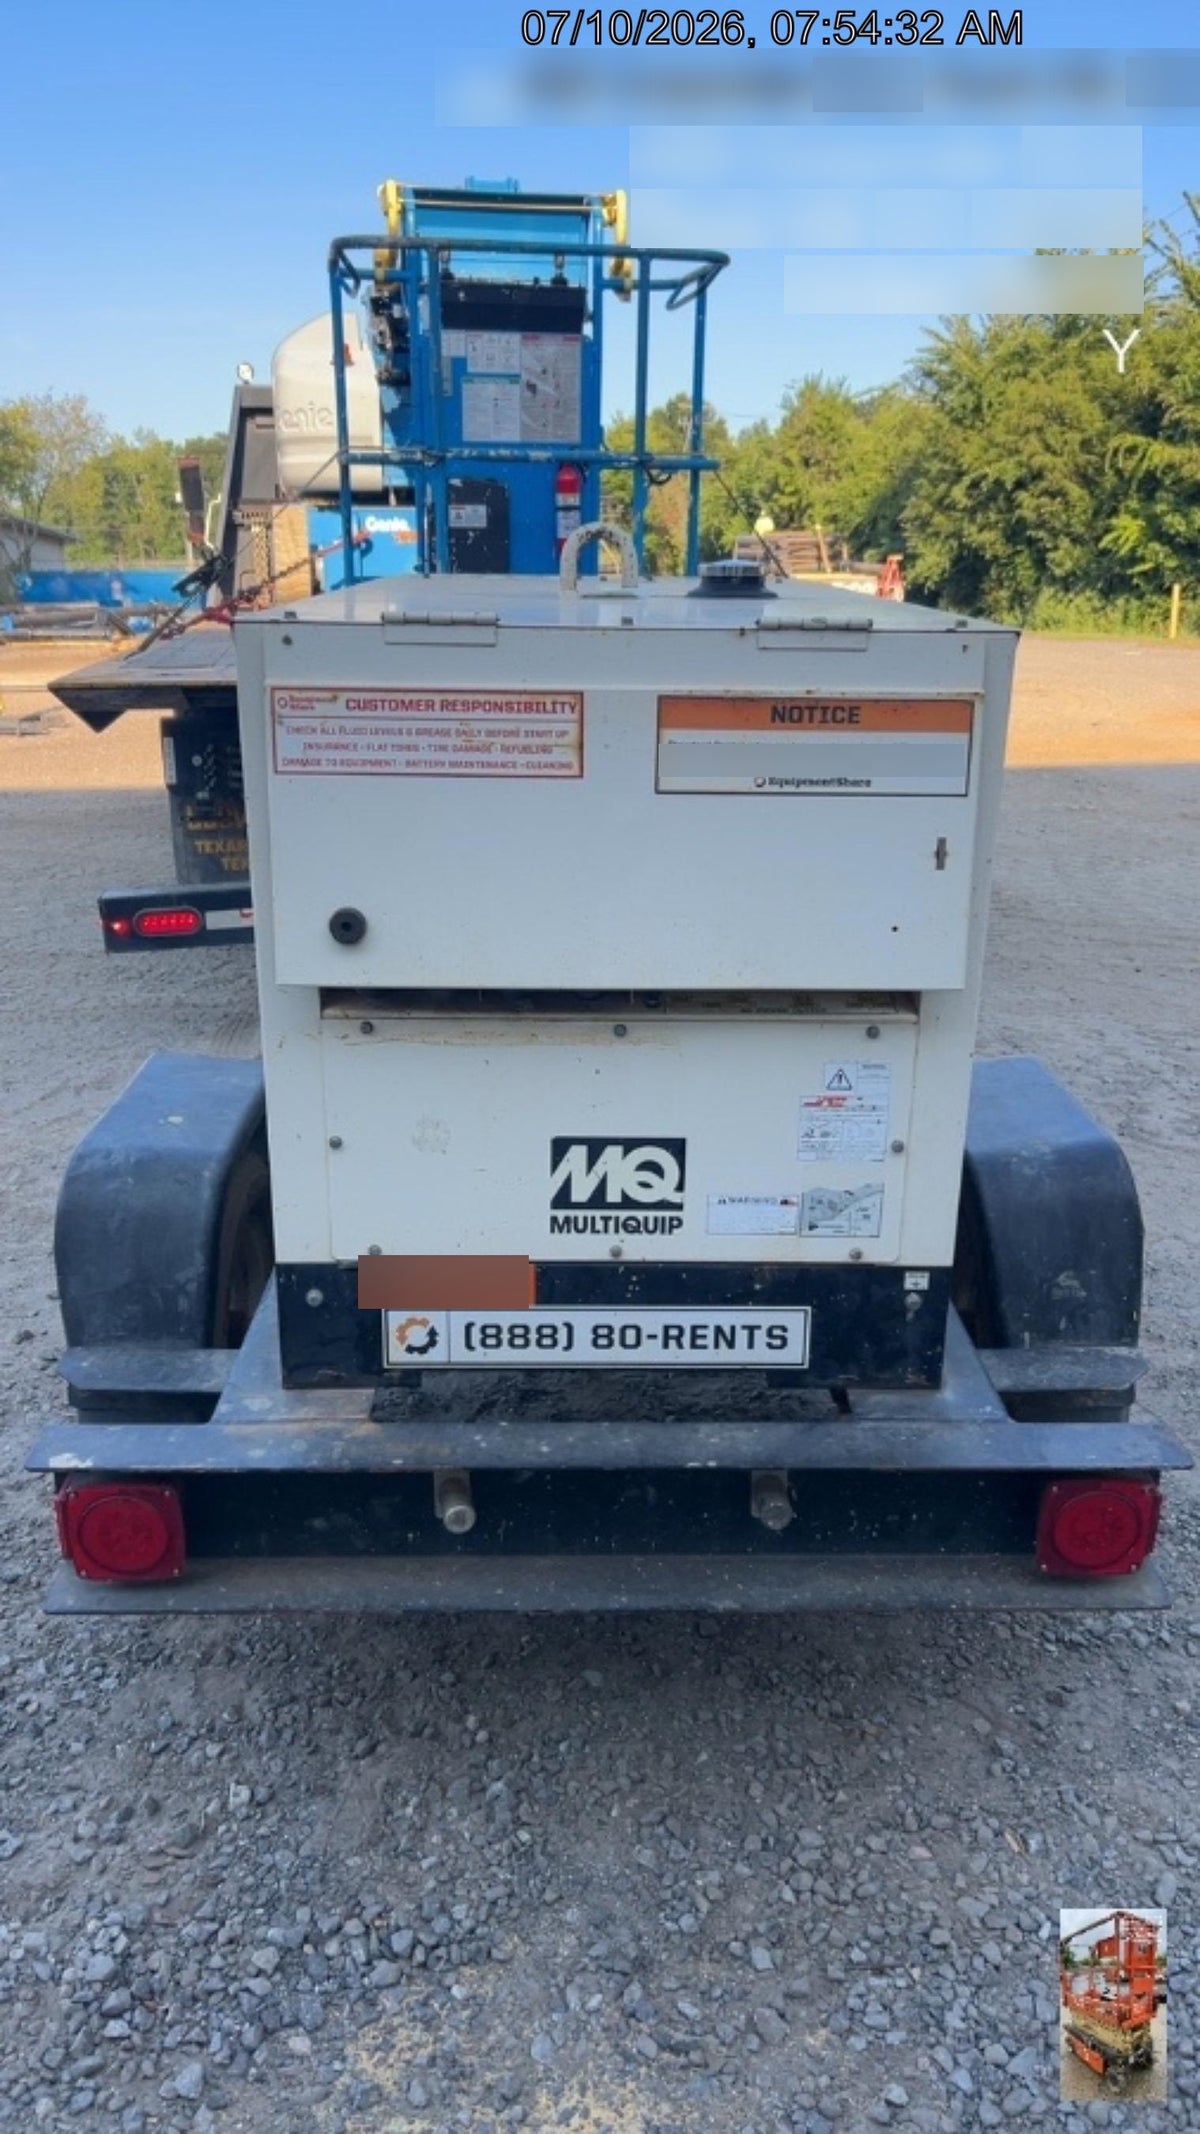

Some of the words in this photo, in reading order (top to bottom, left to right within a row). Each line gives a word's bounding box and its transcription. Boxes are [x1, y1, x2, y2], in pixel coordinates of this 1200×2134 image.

[346, 699, 435, 712] CUSTOMER
[441, 699, 577, 714] RESPONSIBILITY
[771, 705, 862, 724] NOTICE
[320, 725, 337, 735] ALL
[339, 726, 368, 736] FLUID
[369, 727, 404, 737] LEVELS
[415, 728, 452, 738] GREASE
[455, 728, 483, 738] DAILY
[485, 728, 521, 738] BEFORE
[555, 729, 570, 739] UP
[303, 742, 358, 752] INSURANCE
[367, 742, 388, 752] FLAT
[452, 743, 492, 754] DAMAGE
[500, 744, 553, 755] REFUELING
[282, 757, 322, 767] DAMAGE
[325, 758, 337, 767] TO
[340, 758, 397, 768] EQUIPMENT
[405, 759, 446, 769] BATTERY
[448, 760, 518, 769] MAINTENANCE
[526, 761, 574, 770] CLEANING
[768, 777, 872, 788] EquipmentShare
[550, 1144, 684, 1203] MQ
[550, 1215, 684, 1235] MULTIQUIP
[464, 1322, 575, 1352] (888)
[591, 1323, 789, 1351] 80-RENTS
